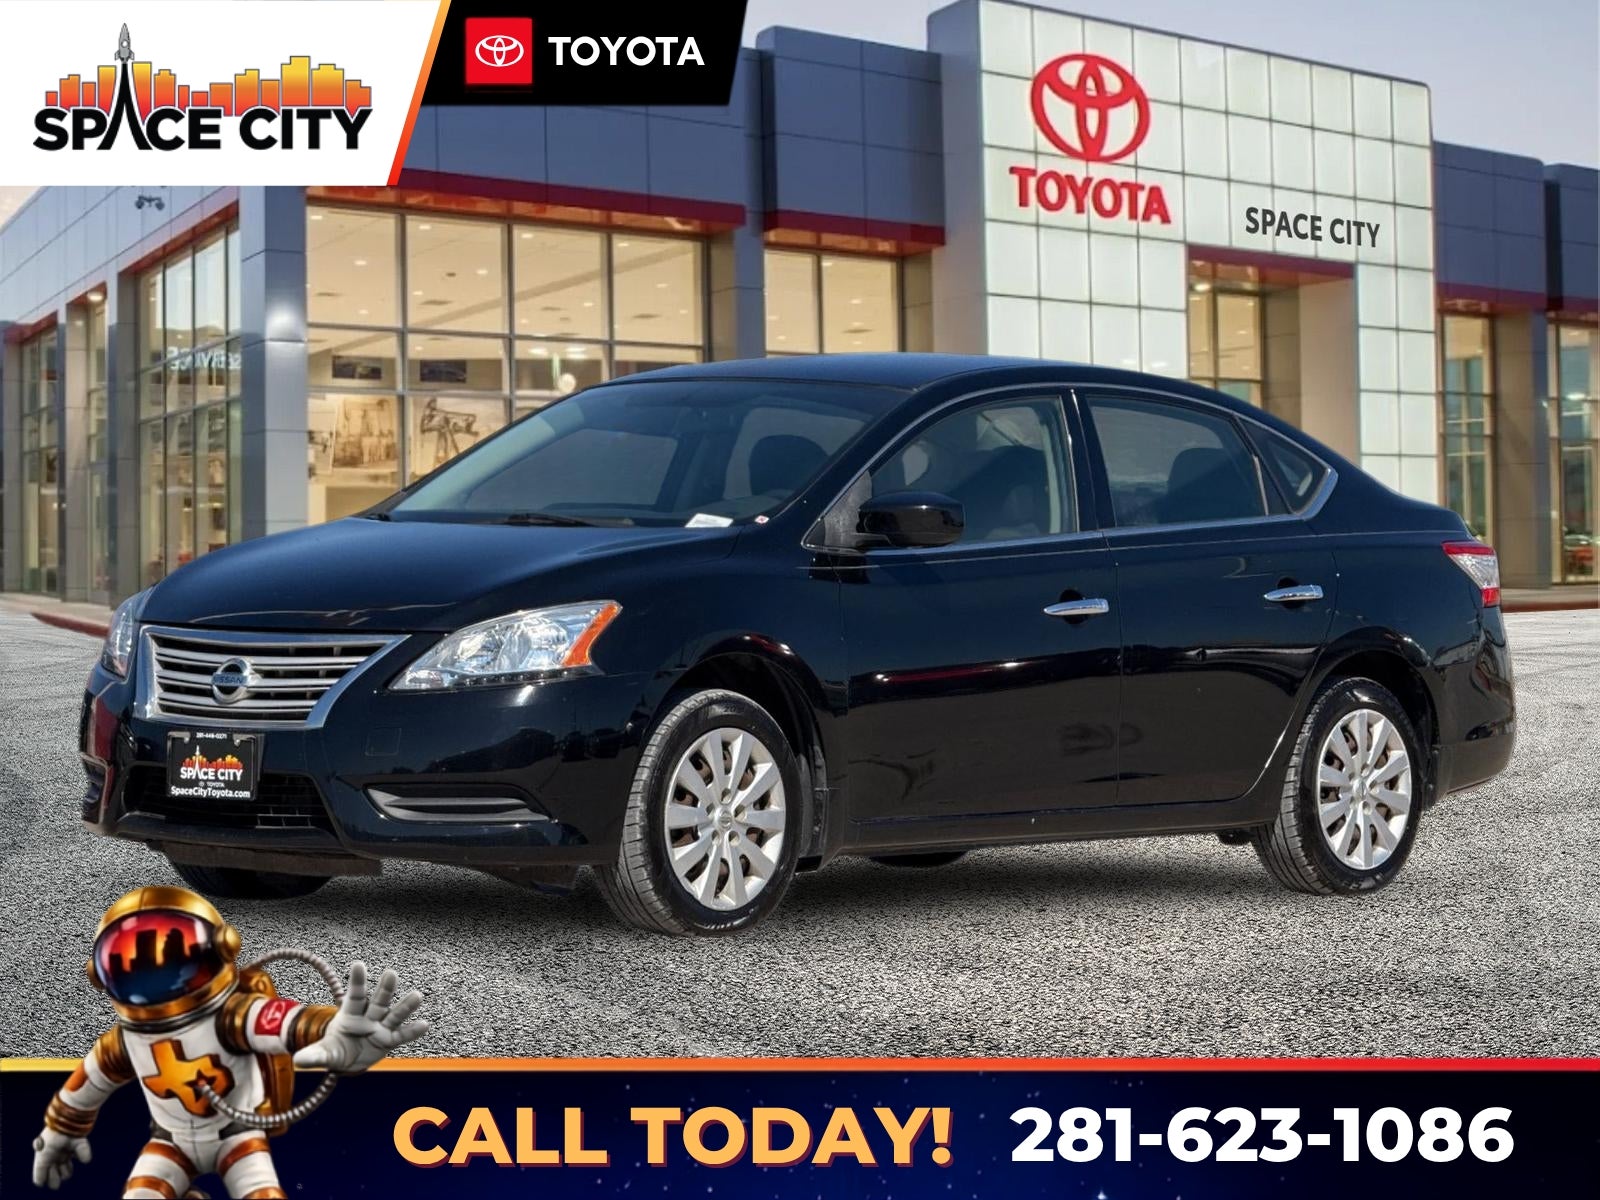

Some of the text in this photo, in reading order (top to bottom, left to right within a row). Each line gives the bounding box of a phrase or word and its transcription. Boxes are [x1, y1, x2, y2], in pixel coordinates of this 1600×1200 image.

[1009, 166, 1171, 224] TOYOTA
[1245, 206, 1380, 248] SPACE CITY
[180, 764, 243, 781] SPACE CITY
[171, 785, 251, 798] SpaceCityToyota.com
